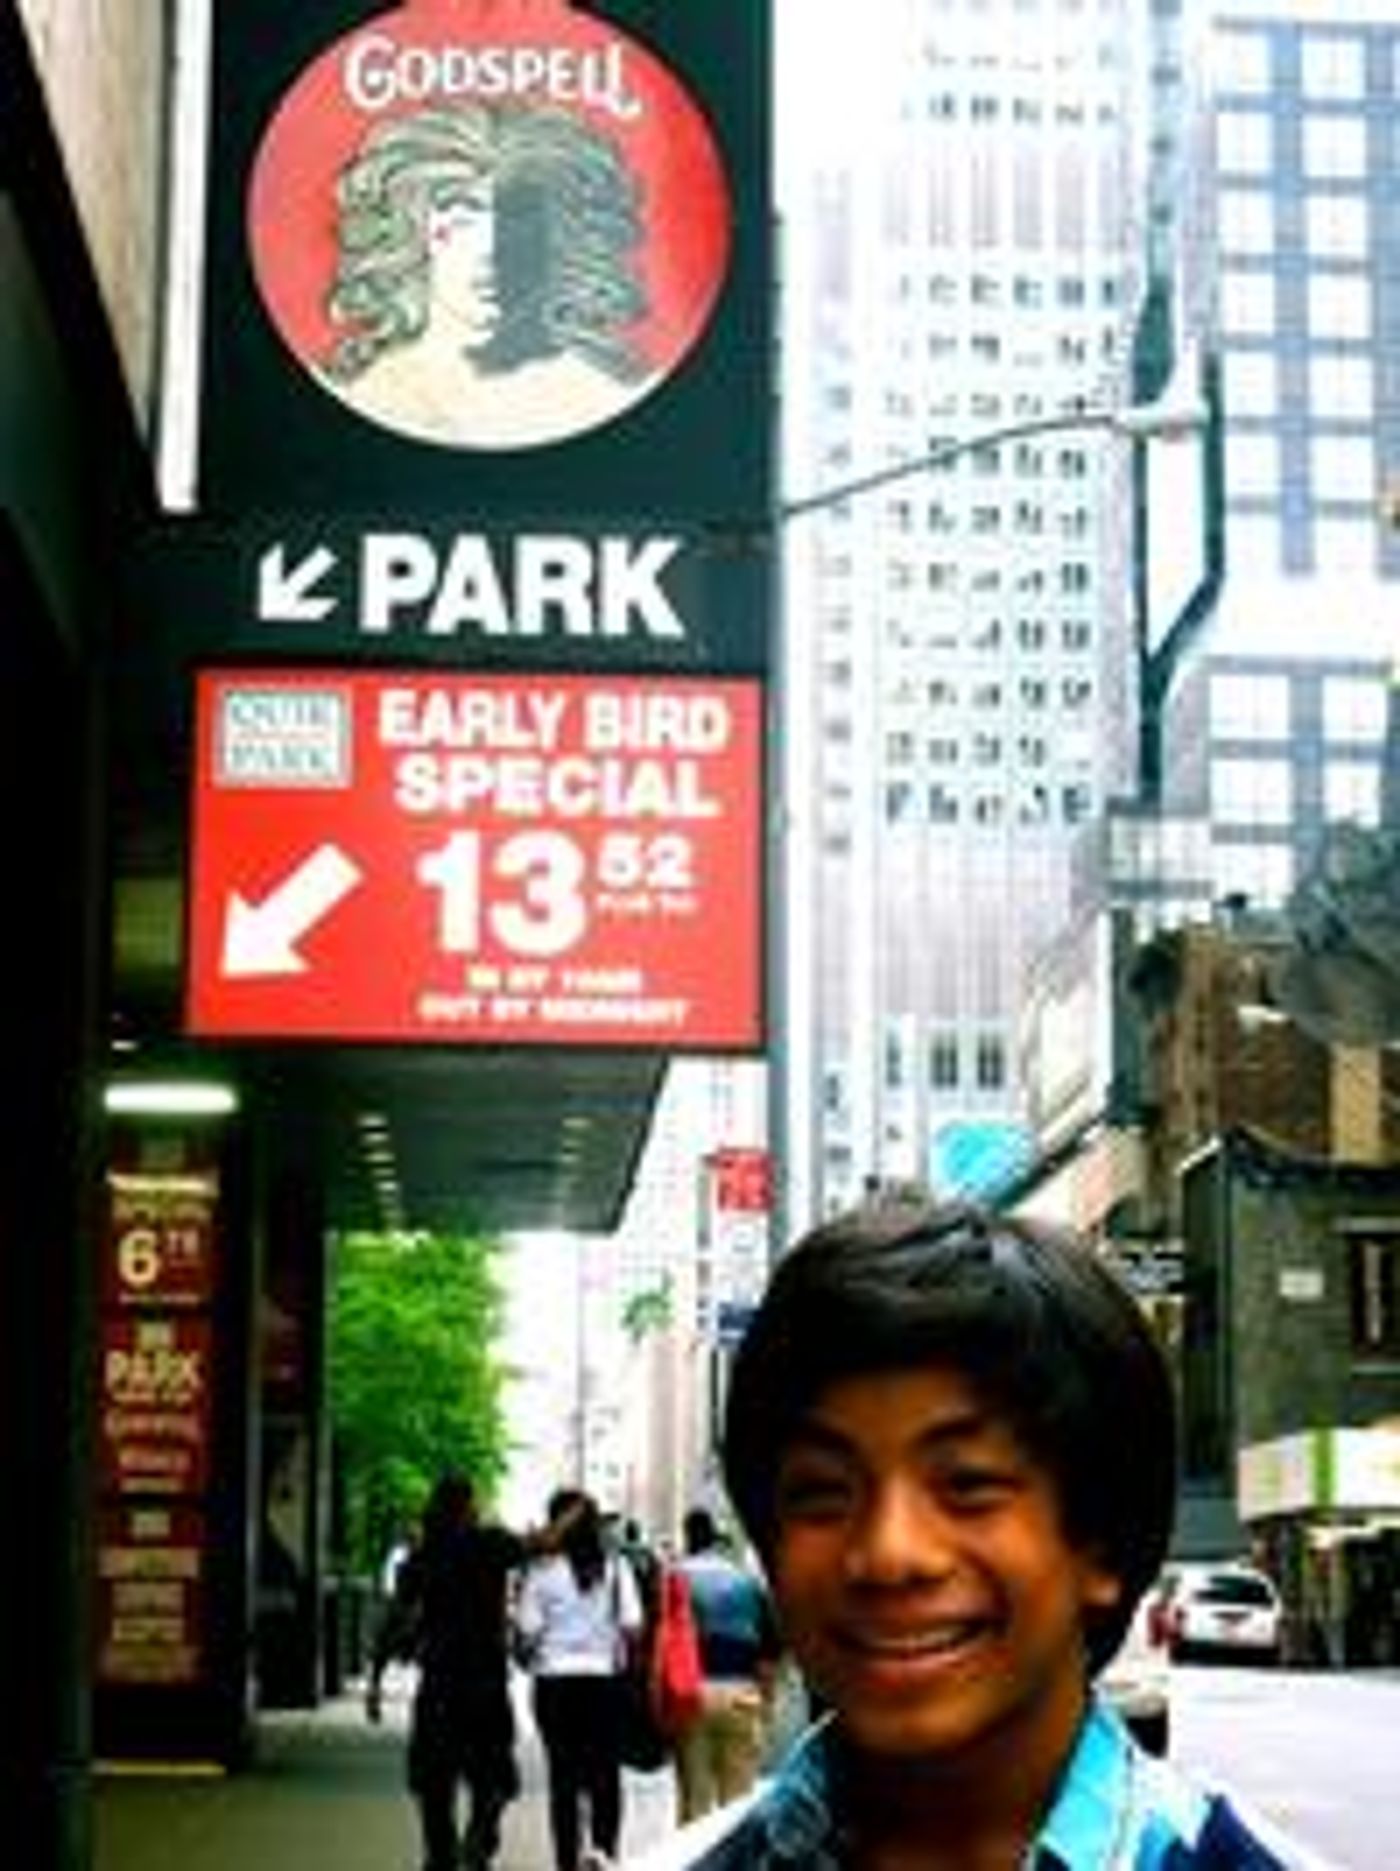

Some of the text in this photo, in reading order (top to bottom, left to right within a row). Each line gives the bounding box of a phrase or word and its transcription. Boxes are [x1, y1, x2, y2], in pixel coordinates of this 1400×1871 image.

[344, 36, 643, 120] GODSPELL
[359, 534, 685, 637] PARK
[378, 690, 730, 752] EARLY BIRD
[394, 754, 721, 817] SPECIAL
[415, 831, 692, 956] 13 52
